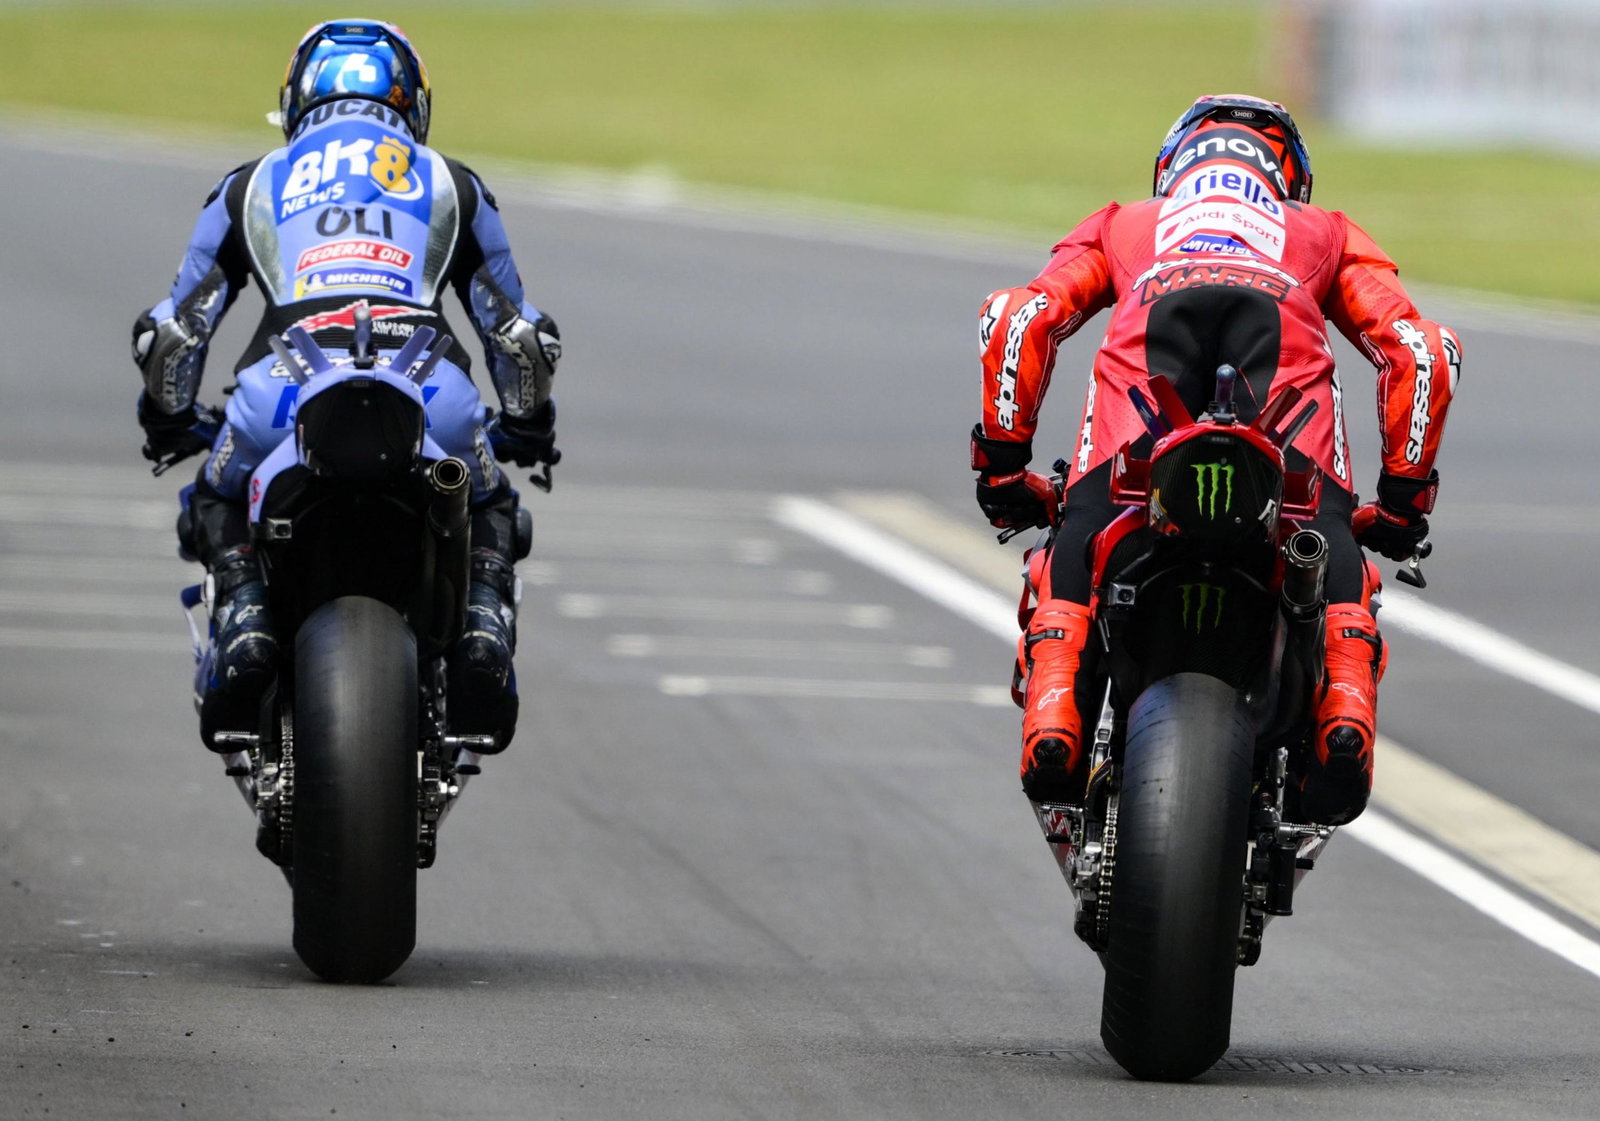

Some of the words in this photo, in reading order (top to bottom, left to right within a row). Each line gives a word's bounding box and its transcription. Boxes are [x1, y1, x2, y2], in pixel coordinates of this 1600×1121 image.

[281, 137, 411, 200] BK8
[281, 181, 345, 218] NEWS
[1194, 170, 1280, 215] riello
[1183, 211, 1225, 226] Audi
[1232, 212, 1280, 246] Sport
[302, 242, 375, 266] FEDERAL
[379, 250, 405, 265] OIL
[325, 272, 406, 291] MICHELIN
[1140, 266, 1290, 306] MARC
[994, 292, 1049, 431] alpinestars
[1391, 319, 1437, 465] alpinestars
